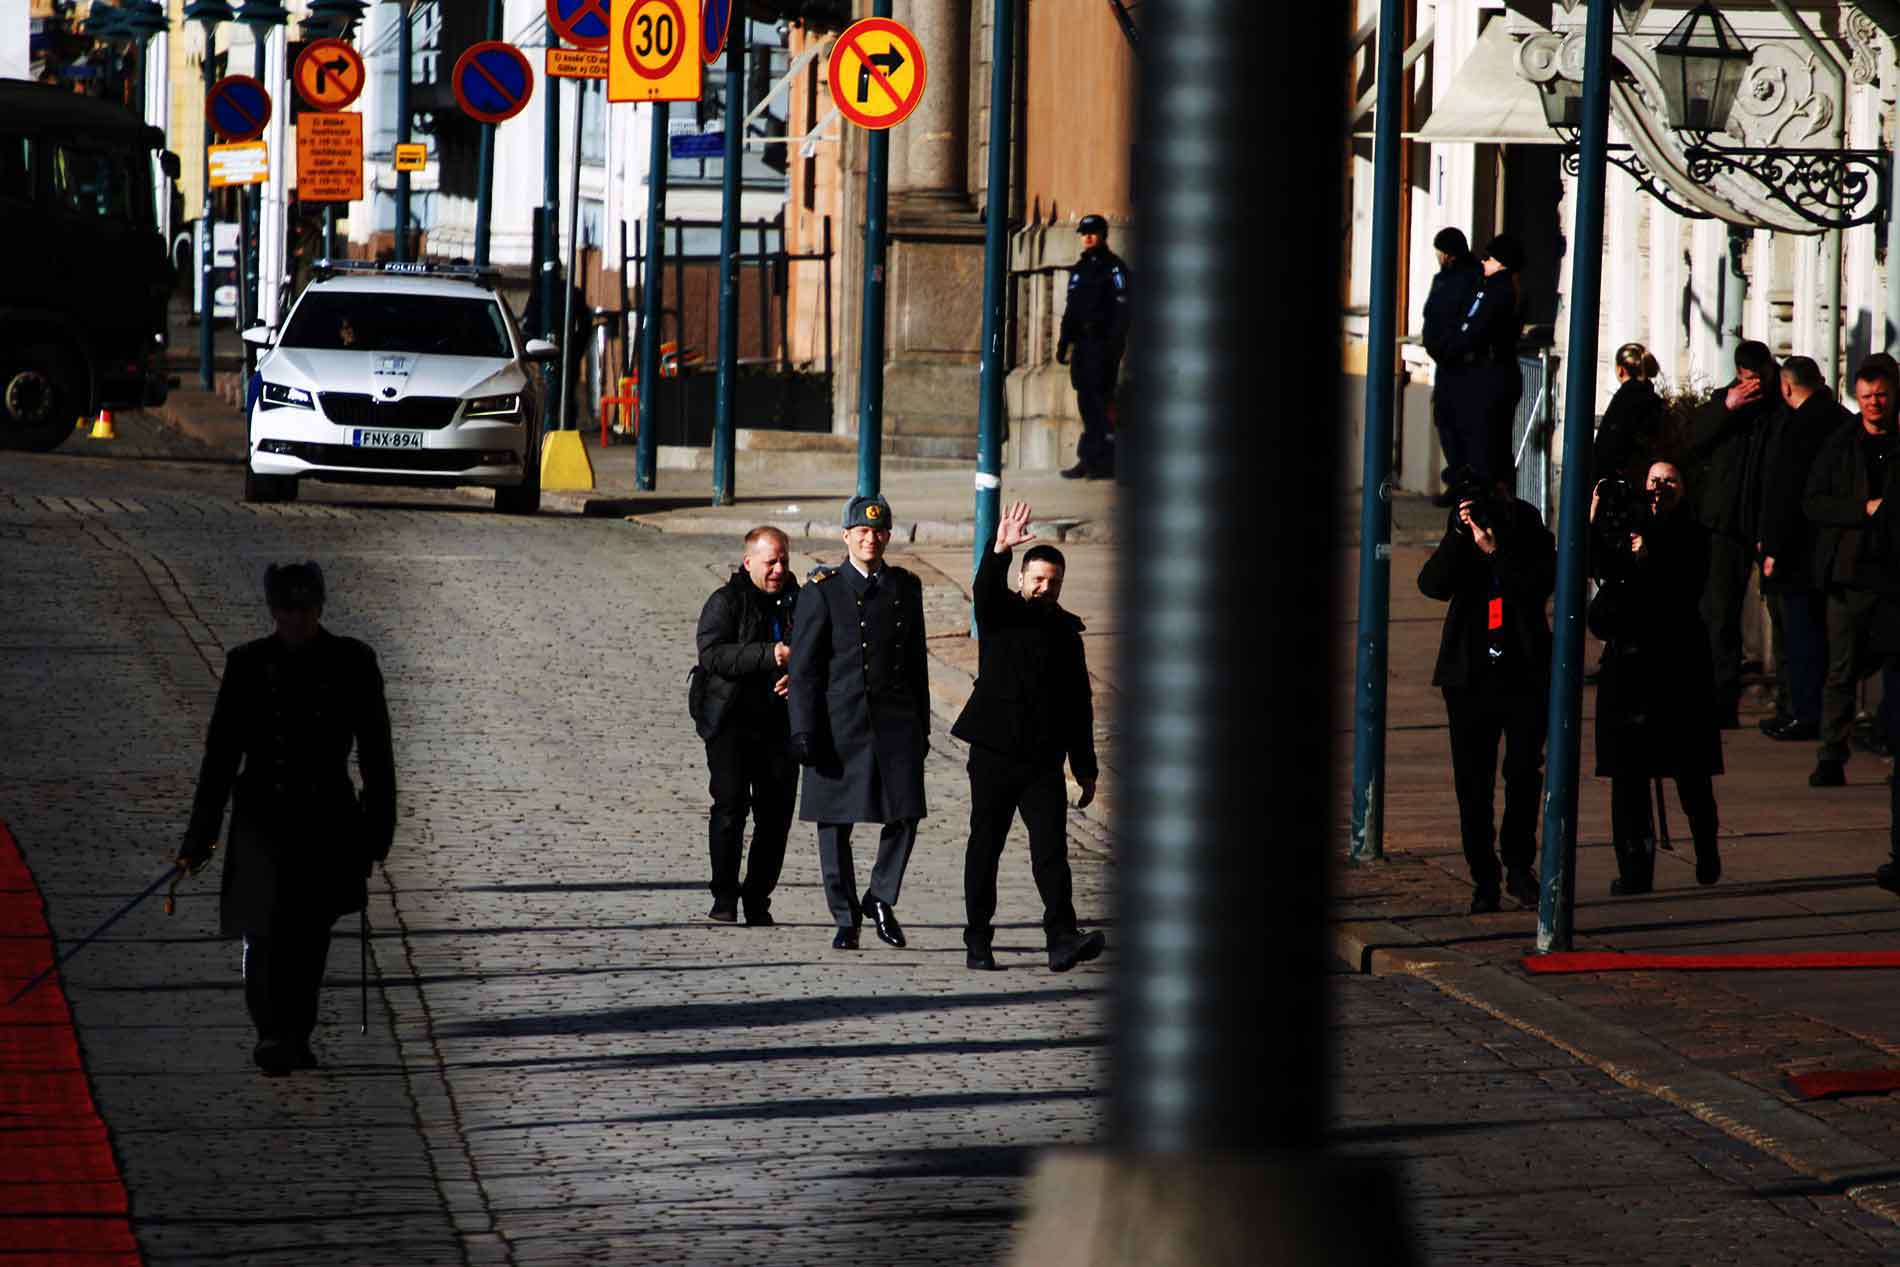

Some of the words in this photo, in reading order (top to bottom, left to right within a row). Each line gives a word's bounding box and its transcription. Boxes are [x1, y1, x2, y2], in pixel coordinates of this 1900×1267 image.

[635, 14, 673, 57] 30
[384, 263, 426, 273] POLIISI
[363, 432, 419, 447] FNX-894
